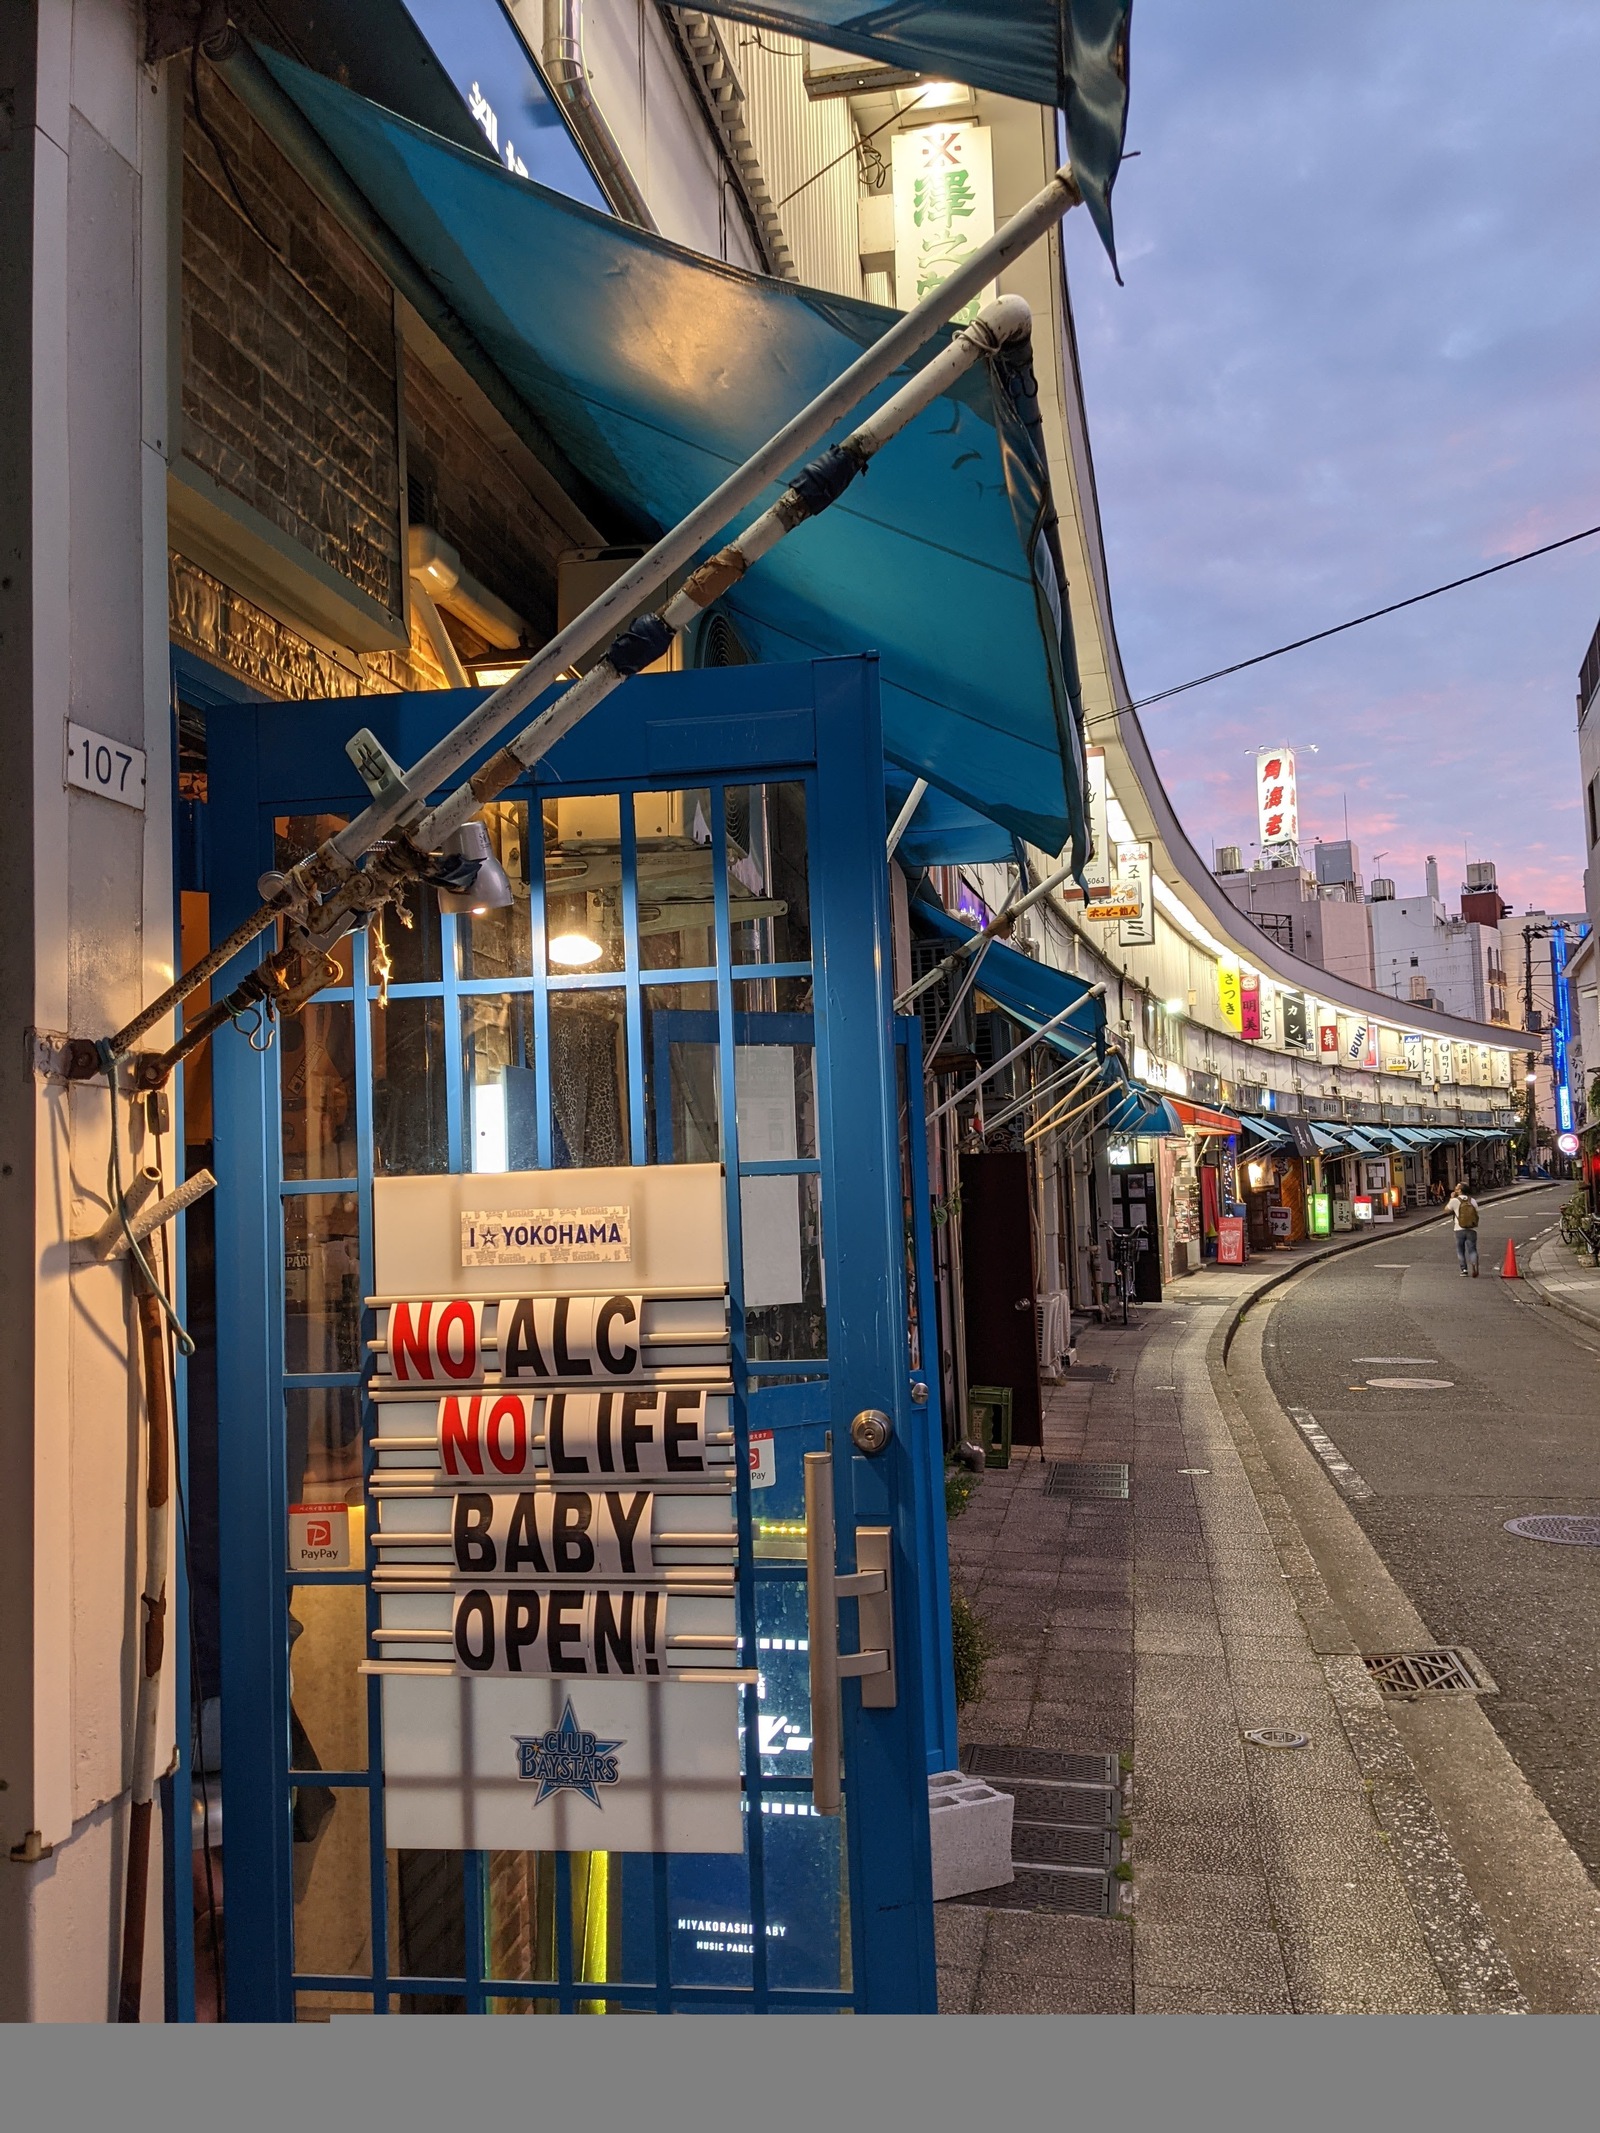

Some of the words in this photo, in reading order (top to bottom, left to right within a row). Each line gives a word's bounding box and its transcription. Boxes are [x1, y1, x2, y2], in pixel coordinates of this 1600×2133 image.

[83, 740, 132, 791] 107
[1263, 759, 1283, 836] 角海老
[1224, 973, 1236, 1016] さつき
[1242, 1000, 1258, 1032] 明美
[1349, 1026, 1367, 1059] IBUKI
[502, 1222, 621, 1246] YOKOHAMA
[284, 1255, 311, 1268] PARI
[391, 1300, 476, 1380] NO
[505, 1295, 638, 1378] ALC
[441, 1394, 527, 1476] NO
[548, 1390, 705, 1474] LIFE
[454, 1491, 652, 1574] BABY
[301, 1548, 338, 1560] PayPay
[454, 1588, 661, 1676] OPEN!
[543, 1731, 597, 1757] CLUB
[518, 1742, 620, 1784] BAYSTARS
[677, 1918, 754, 1935] MIYAKOBASHI
[696, 1940, 724, 1951] MUSIC
